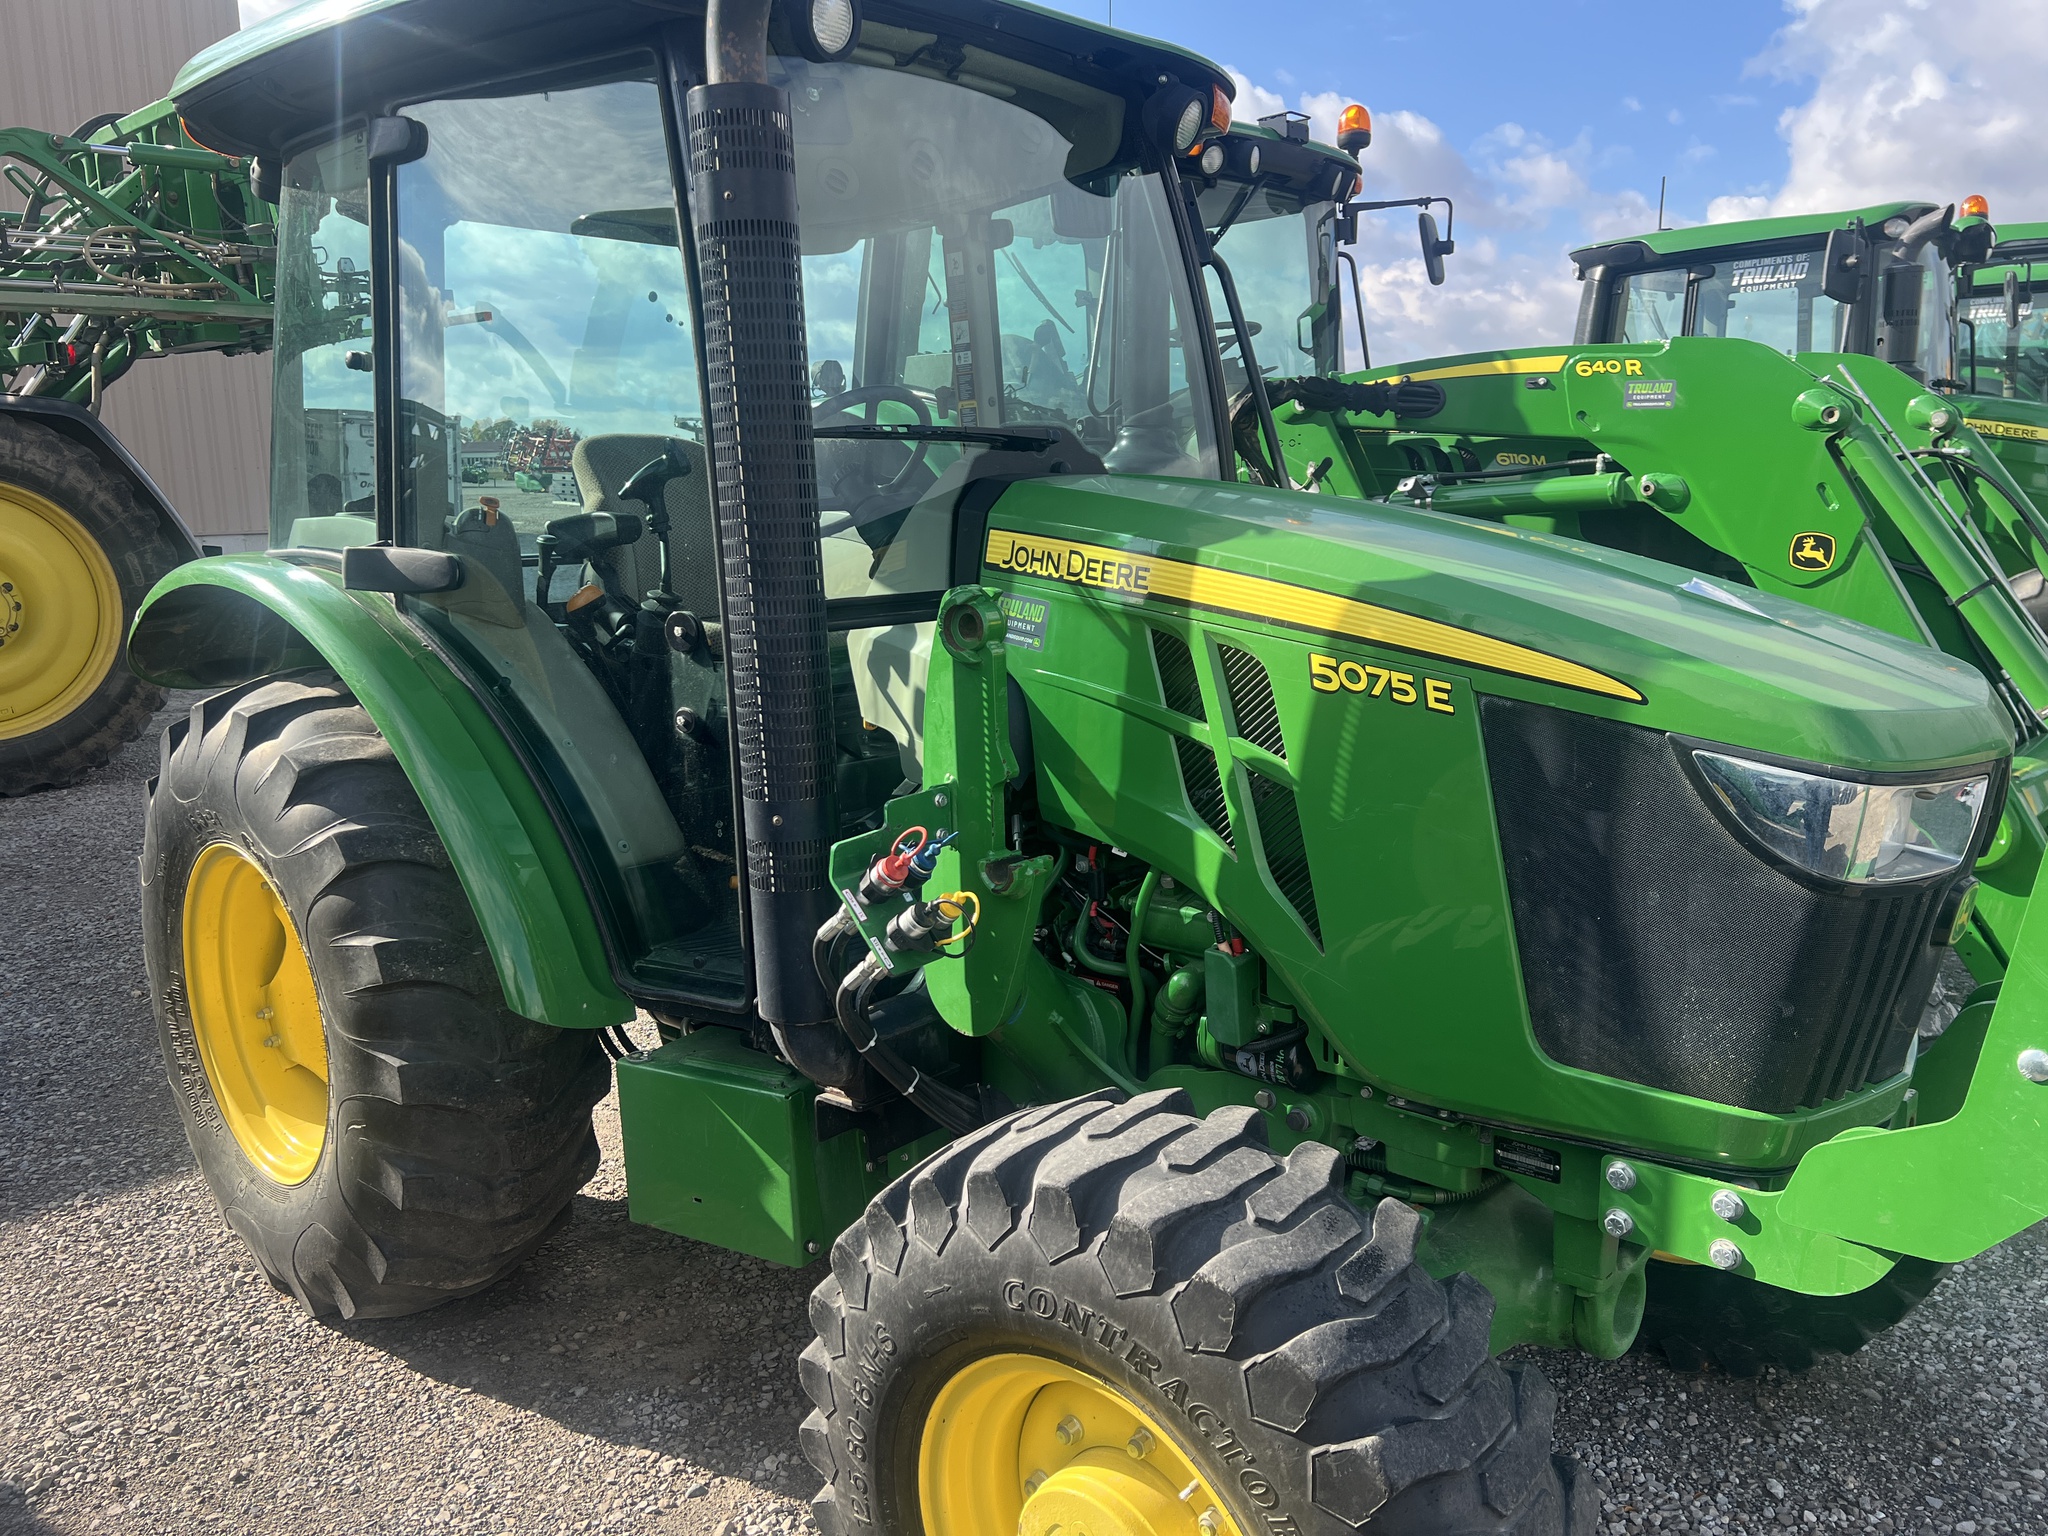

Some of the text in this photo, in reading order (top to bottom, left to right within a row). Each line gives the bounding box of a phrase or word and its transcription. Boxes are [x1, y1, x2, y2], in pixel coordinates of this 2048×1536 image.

[1733, 253, 1811, 270] COMPLIMENTS OF:
[1731, 262, 1809, 286] TRULAND
[1740, 281, 1797, 293] EQUIPMENT
[1575, 359, 1644, 377] 640 R
[1628, 382, 1673, 394] TRULAND
[1995, 424, 2038, 438] DEERE
[1496, 452, 1546, 466] 6110 M
[1002, 540, 1150, 591] JOHN DEERE
[1007, 619, 1036, 632] UIPMENT
[1308, 652, 1455, 716] 5075 E
[162, 989, 208, 1130] INDUSTRIAL
[180, 1028, 223, 1138] TRACTOR
